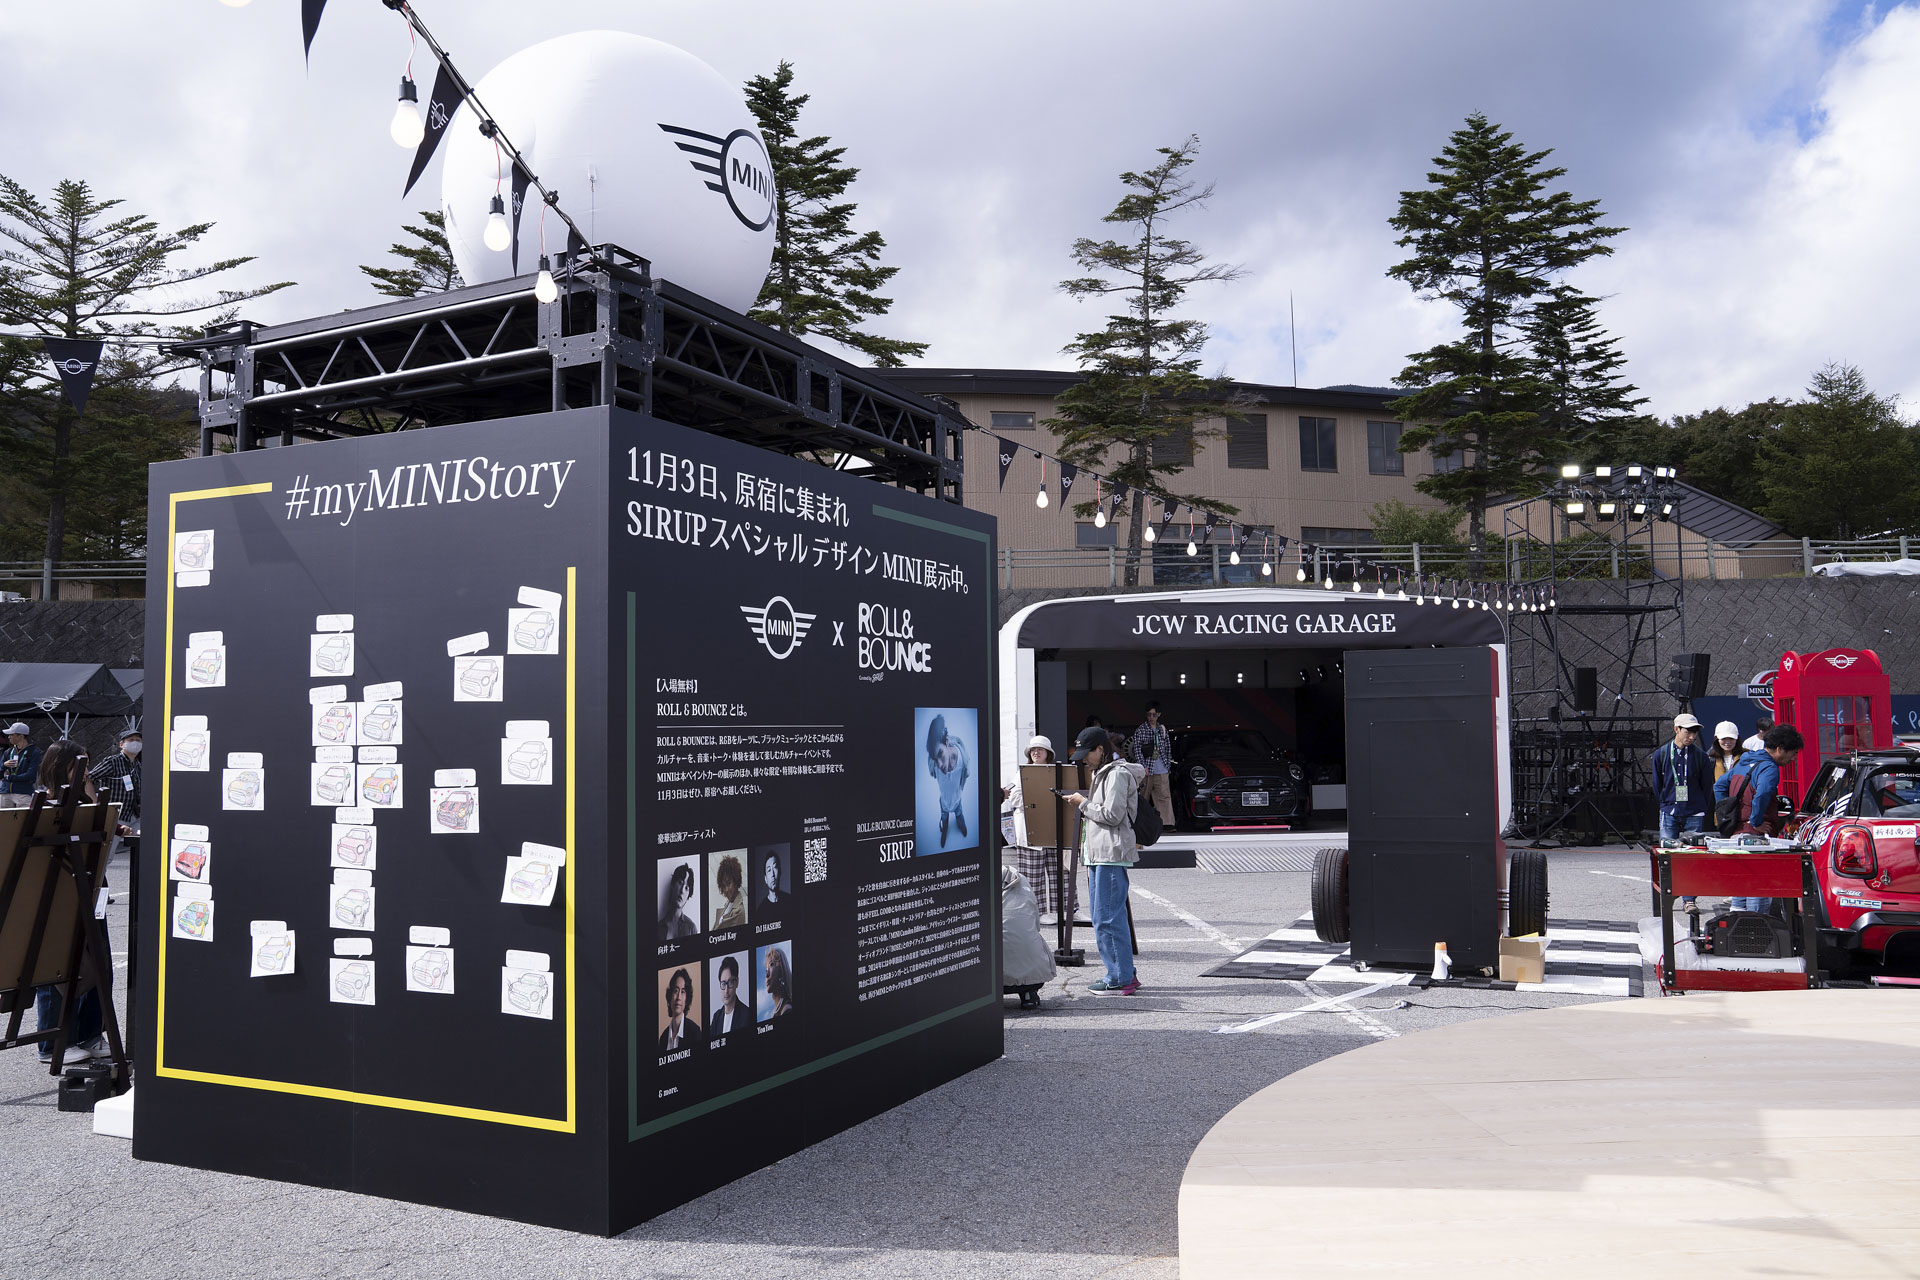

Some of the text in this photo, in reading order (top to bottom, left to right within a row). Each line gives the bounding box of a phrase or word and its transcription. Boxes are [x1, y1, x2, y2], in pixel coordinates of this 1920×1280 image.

[732, 157, 770, 202] MINI
[285, 456, 576, 527] #myMINIStory
[627, 446, 850, 528] 11月3日、原宿に集まれ
[767, 618, 793, 637] MINI
[1132, 613, 1397, 635] JCW RACING GARAGE
[858, 636, 932, 673] BOUNCE
[656, 677, 698, 694] 【入場無料】
[656, 703, 682, 717] ROLL
[683, 703, 690, 716] &
[691, 703, 728, 717] BOUNCE
[656, 736, 676, 747] ROLL
[676, 736, 682, 747] &
[879, 839, 914, 863] SIRUP
[708, 931, 737, 945] Crystal Kay
[658, 1048, 692, 1066] DJ KOMORI
[663, 1085, 679, 1096] more.
